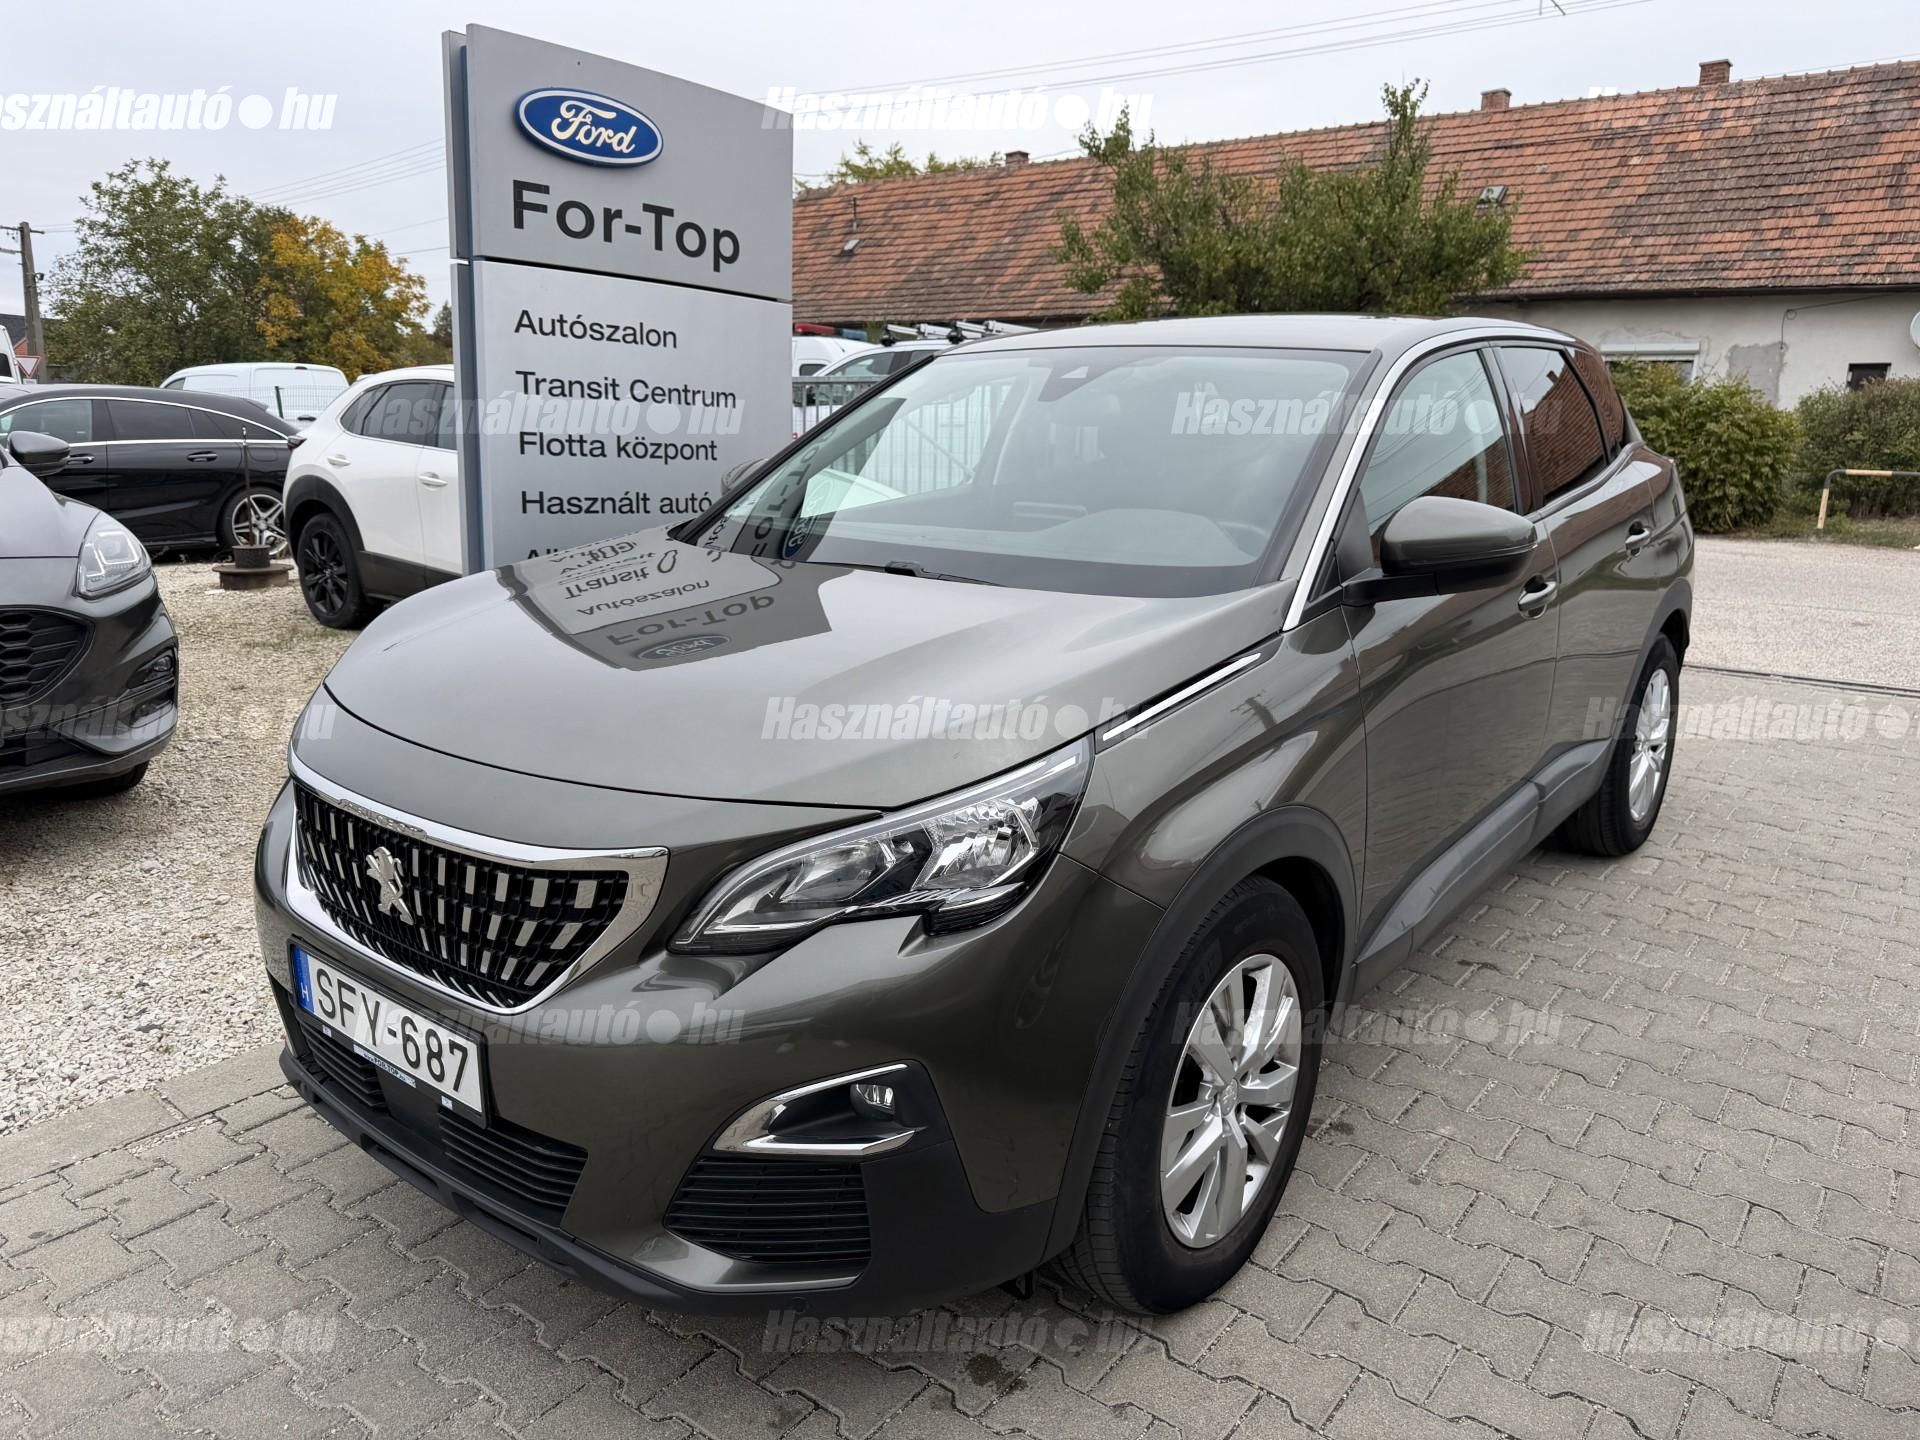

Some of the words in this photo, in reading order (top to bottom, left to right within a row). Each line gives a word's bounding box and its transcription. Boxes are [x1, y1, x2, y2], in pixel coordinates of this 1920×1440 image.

[551, 99, 637, 154] Ford
[512, 179, 740, 272] For-Top
[514, 309, 678, 348] Autószalon
[515, 370, 621, 401] Transit
[629, 379, 737, 409] Centrum
[518, 431, 607, 458] Flotta
[616, 435, 718, 465] központ
[521, 490, 651, 514] Használt
[659, 491, 713, 514] autó
[316, 968, 468, 1092] SFY-687
